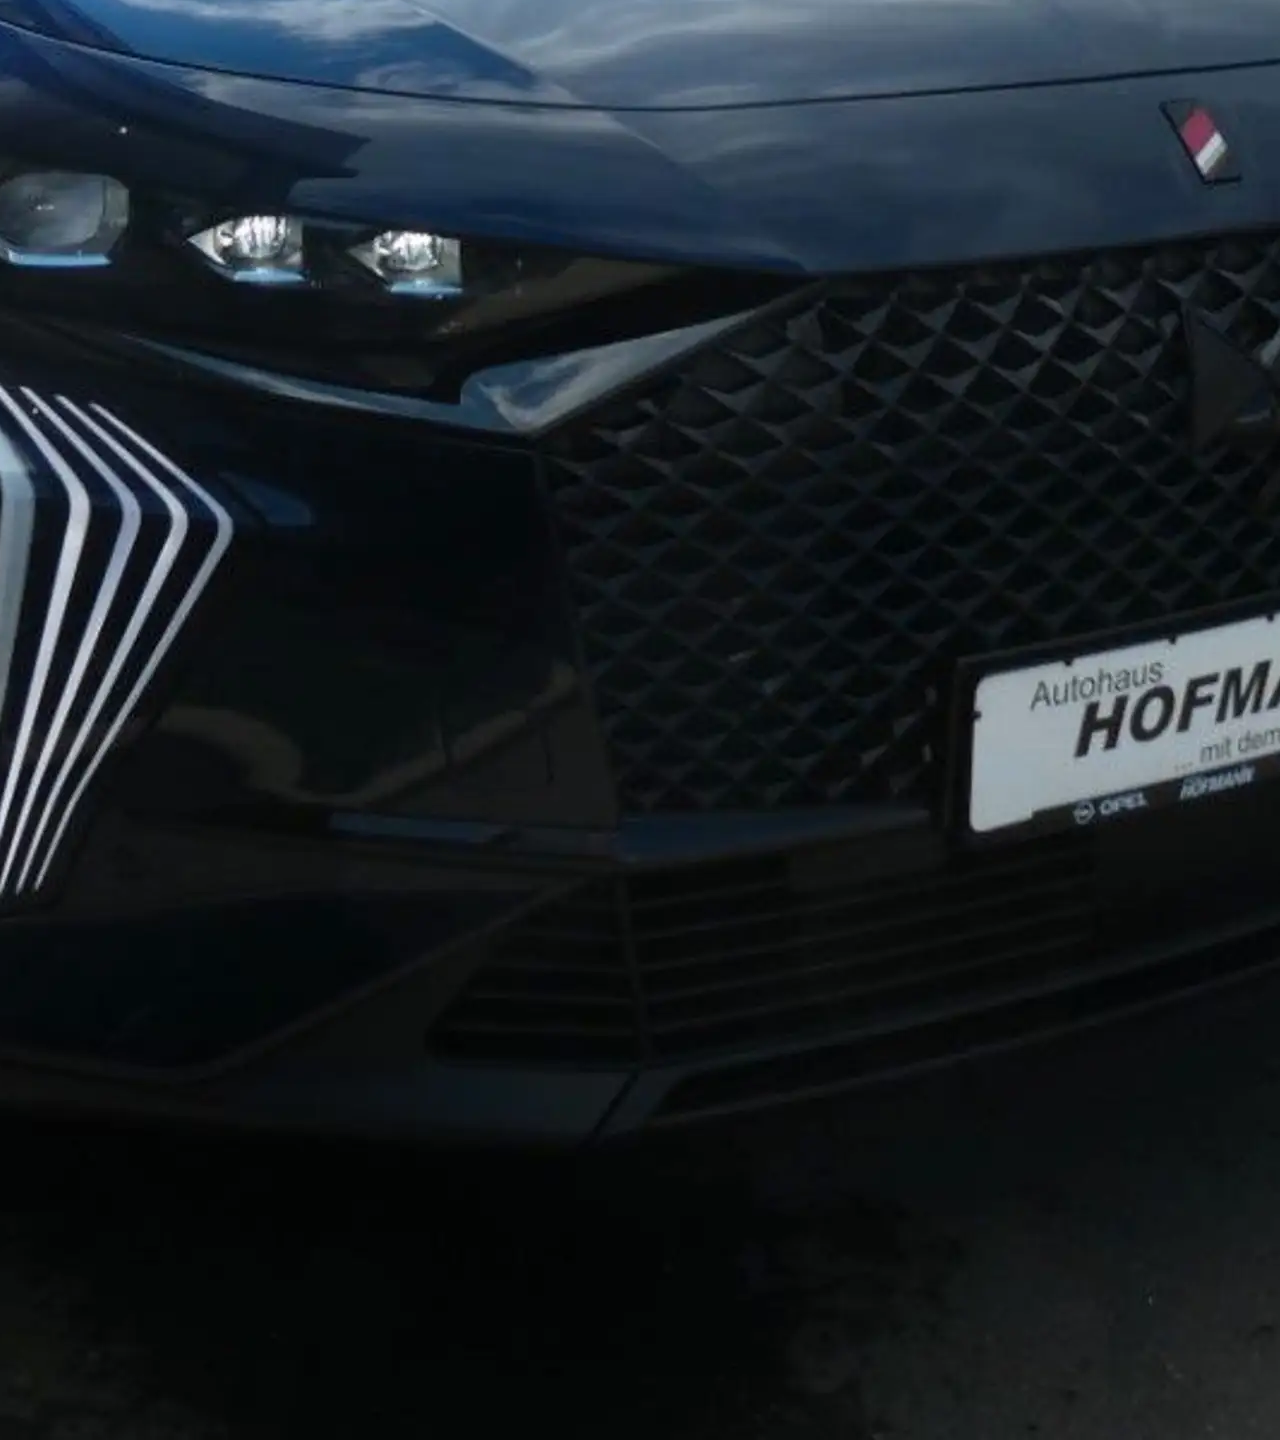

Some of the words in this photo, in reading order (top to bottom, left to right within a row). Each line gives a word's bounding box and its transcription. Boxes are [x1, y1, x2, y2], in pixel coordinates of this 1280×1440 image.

[1030, 661, 1164, 710] Autohaus
[1200, 734, 1232, 762] mit
[1098, 791, 1148, 817] OPEL
